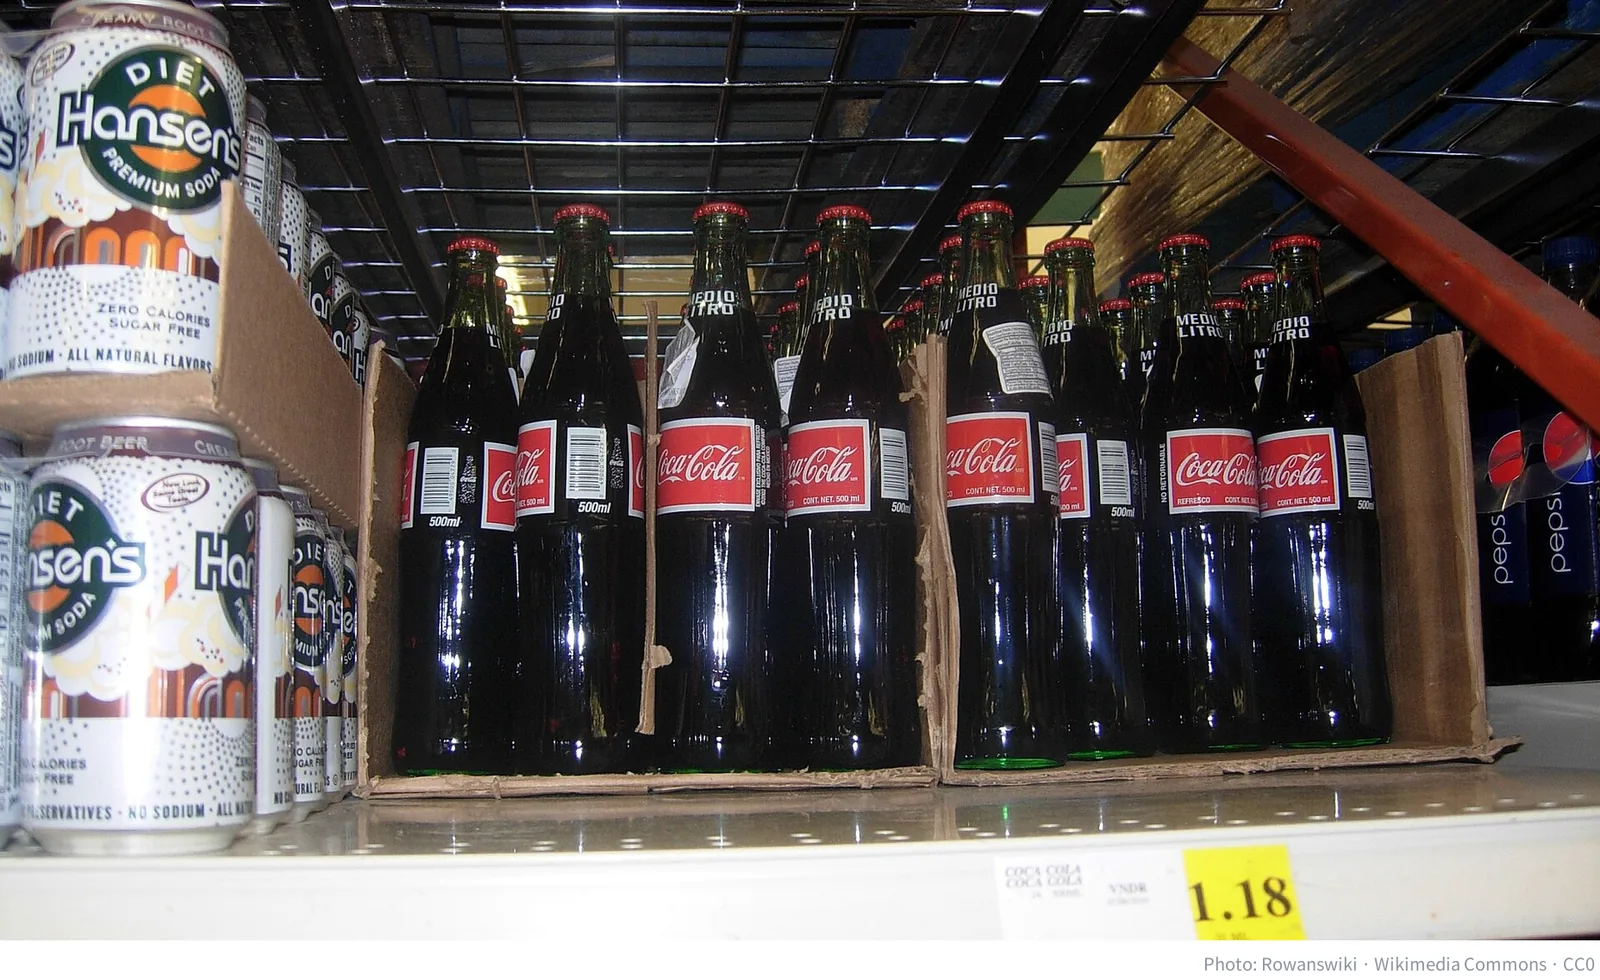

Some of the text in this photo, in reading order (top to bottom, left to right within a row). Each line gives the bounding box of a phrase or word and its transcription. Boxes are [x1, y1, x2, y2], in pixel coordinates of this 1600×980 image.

[125, 57, 215, 97] DIET
[62, 92, 241, 171] Hansen's
[103, 147, 222, 199] PREMIUM SODA
[691, 304, 735, 318] ITRO
[815, 294, 853, 311] EDIO
[956, 296, 997, 313] LITRO
[97, 303, 211, 328] ZERO CALORIES
[812, 306, 851, 325] ITRO
[110, 318, 201, 339] SUGAR FREE
[1047, 320, 1073, 335] DIO
[1271, 328, 1310, 344] ITRO
[1043, 332, 1072, 347] TRO
[18, 349, 54, 368] SODIUM
[68, 349, 89, 361] ALL
[96, 348, 159, 365] NATURAL
[163, 354, 213, 374] FLAVORS
[101, 435, 149, 450] BEER
[1159, 442, 1167, 503] NO RETORNABLE
[966, 487, 985, 495] CONT.
[986, 486, 1001, 494] NET.
[578, 502, 612, 514] 500ml
[803, 497, 820, 505] CONT.
[836, 495, 849, 503] 500
[1177, 496, 1211, 505] REFRESCO
[1277, 499, 1294, 507] CONT.
[1309, 496, 1320, 504] 500
[1111, 507, 1135, 517] 500ml
[429, 516, 461, 527] 500ml
[293, 542, 323, 565] DIE
[1491, 514, 1514, 584] peps
[28, 538, 142, 586] nsen's
[56, 591, 97, 635] SODA
[153, 803, 205, 819] SODIUM
[217, 801, 233, 816] ALL
[1005, 864, 1081, 878] COCA COLA
[1006, 875, 1083, 888] COCA COLA
[1189, 875, 1292, 922] 1.18
